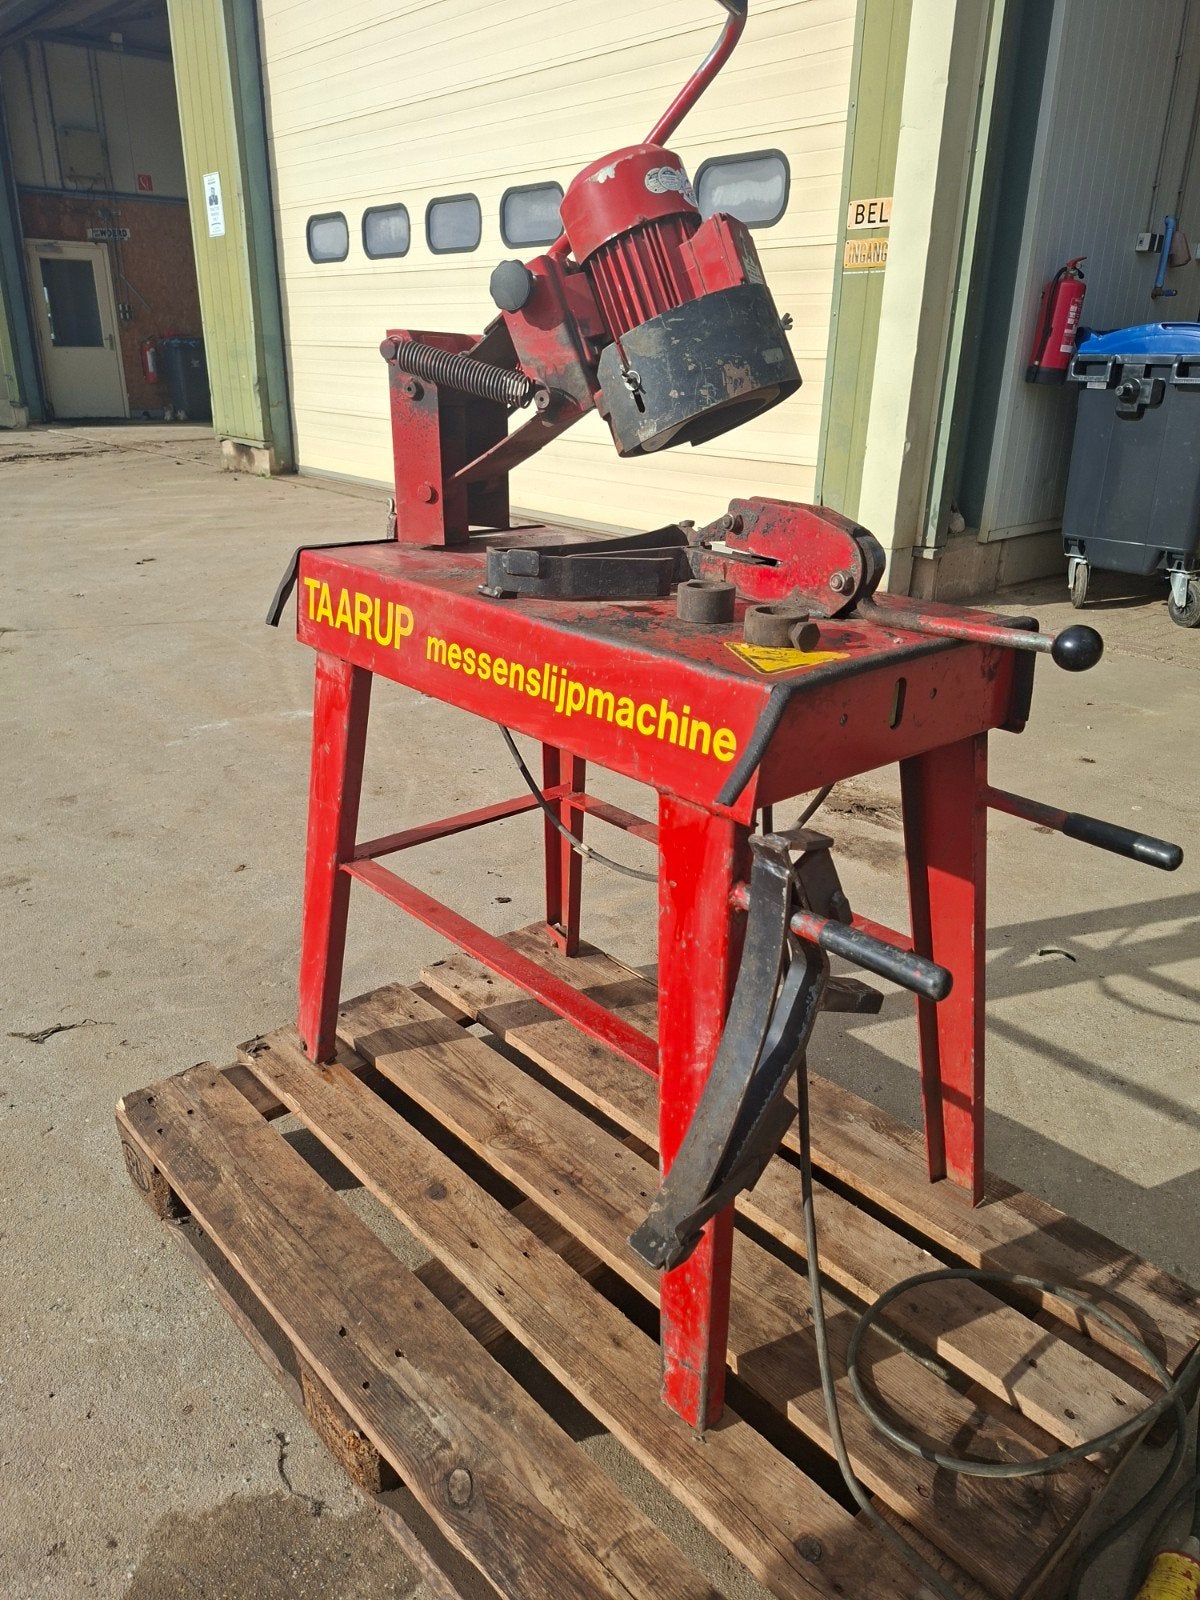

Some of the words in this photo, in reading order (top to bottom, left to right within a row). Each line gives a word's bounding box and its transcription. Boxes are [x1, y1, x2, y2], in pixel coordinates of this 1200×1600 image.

[854, 202, 888, 225] BEL
[848, 241, 888, 263] INGANG
[303, 577, 414, 650] TAARUP
[426, 634, 738, 763] messenslijpmachine
